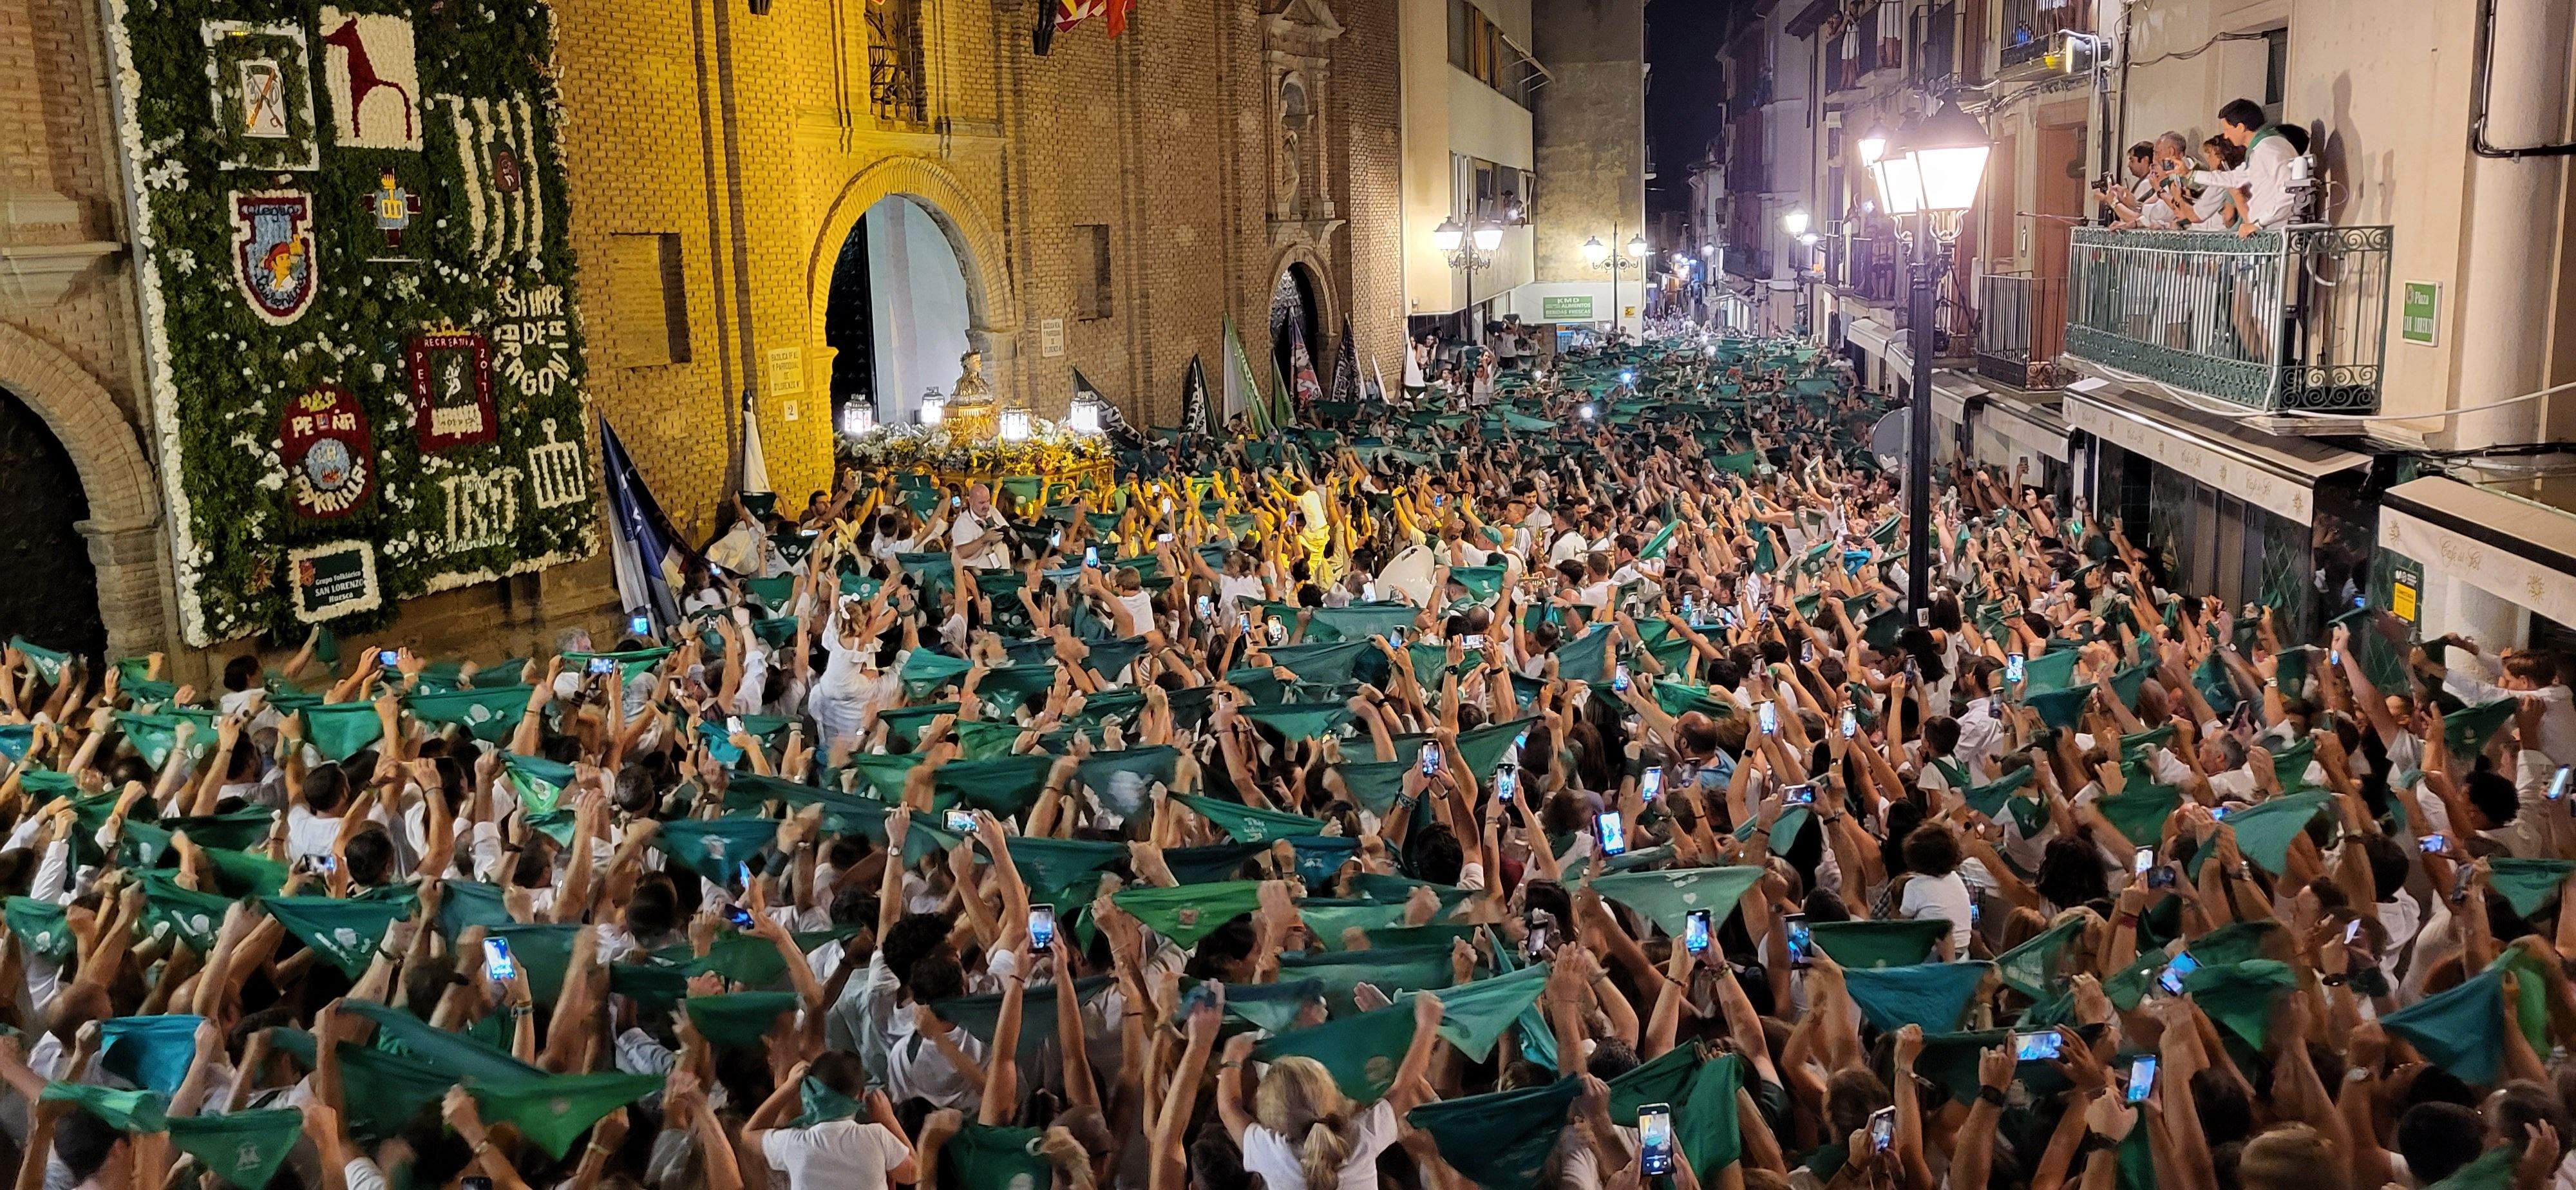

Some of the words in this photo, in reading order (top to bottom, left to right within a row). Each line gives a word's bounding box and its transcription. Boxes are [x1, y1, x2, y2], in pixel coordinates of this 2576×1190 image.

[524, 322, 545, 345] DE
[416, 352, 428, 409] PEÑA
[788, 404, 794, 415] 2
[292, 408, 356, 439] PEÑA
[315, 577, 333, 586] Grupo
[315, 586, 330, 597] SAN
[331, 578, 365, 594] LORENZO
[328, 592, 354, 603] Huesca
